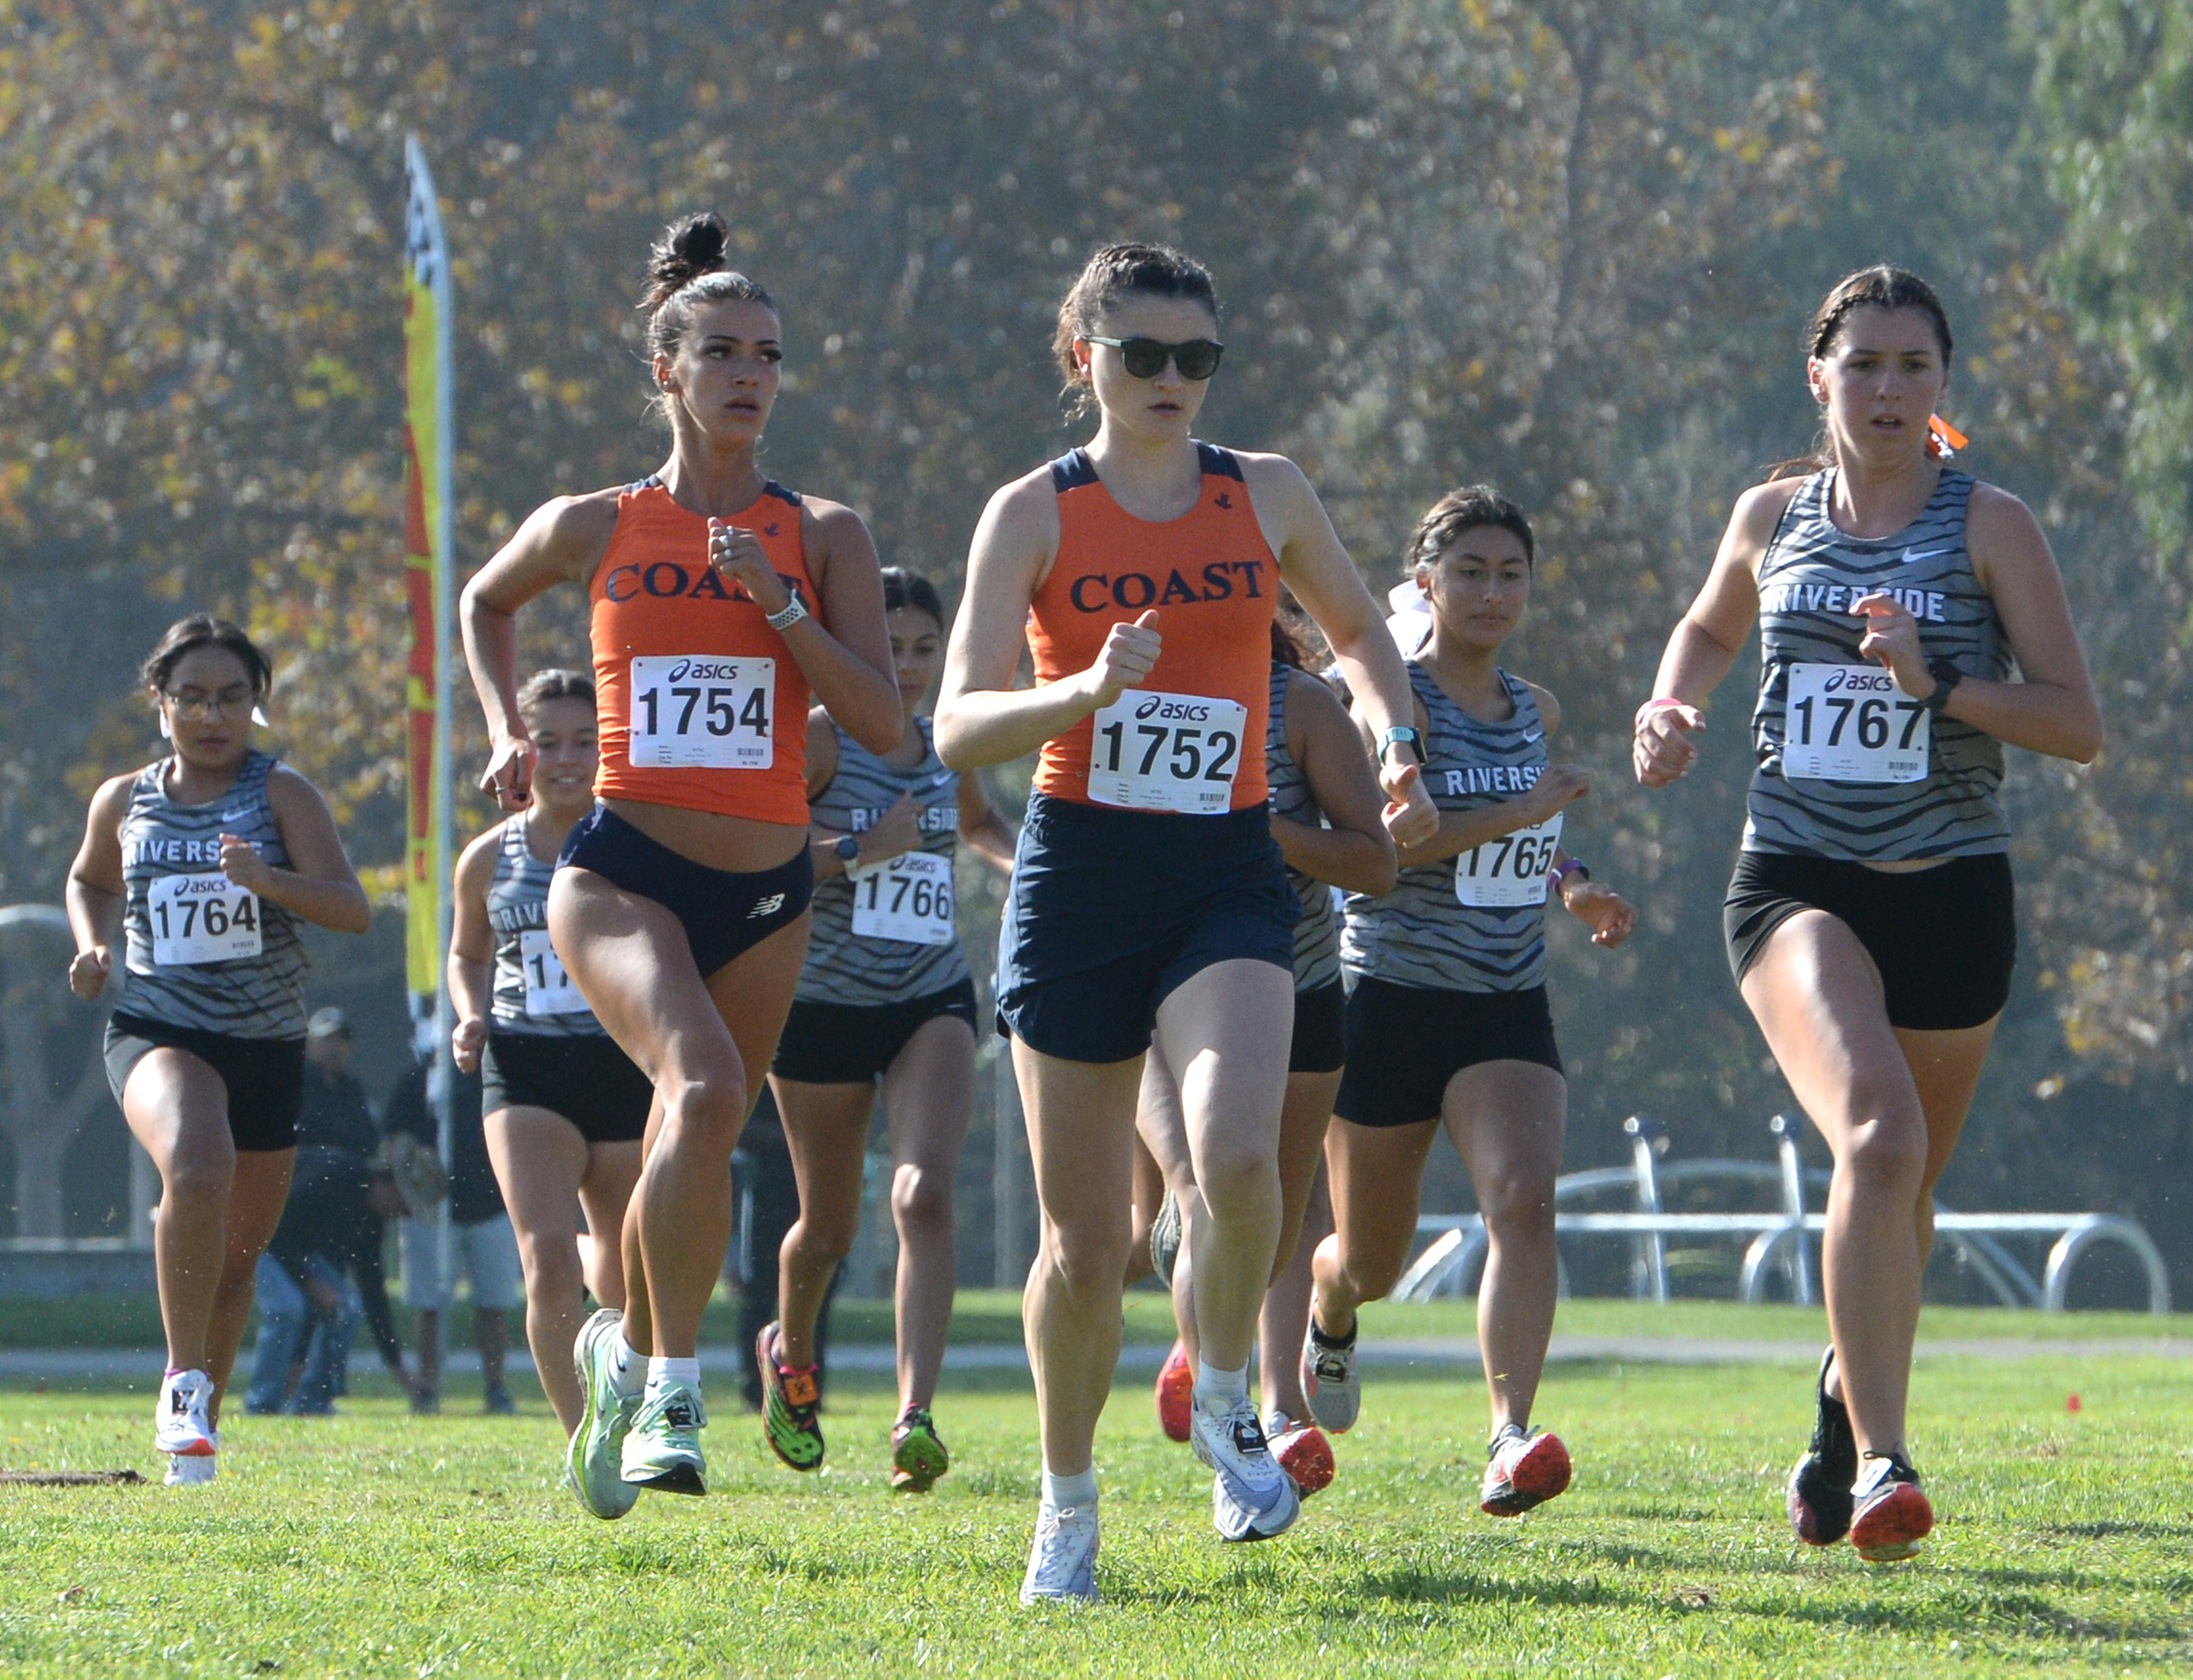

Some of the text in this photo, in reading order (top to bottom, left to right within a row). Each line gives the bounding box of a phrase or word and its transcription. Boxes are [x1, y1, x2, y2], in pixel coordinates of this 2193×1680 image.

[1070, 560, 1264, 613] COAST
[1769, 583, 1946, 622] RIVERIDE
[691, 663, 739, 680] asics
[1846, 675, 1893, 692] asics
[638, 687, 769, 736] 1754
[1160, 702, 1210, 722] asics
[1794, 695, 1927, 750] 1767
[1101, 721, 1237, 783] 1752
[1445, 766, 1545, 796] RIVERS
[1468, 835, 1556, 879] 1765
[154, 895, 257, 940] 1764
[865, 872, 949, 920] 1766
